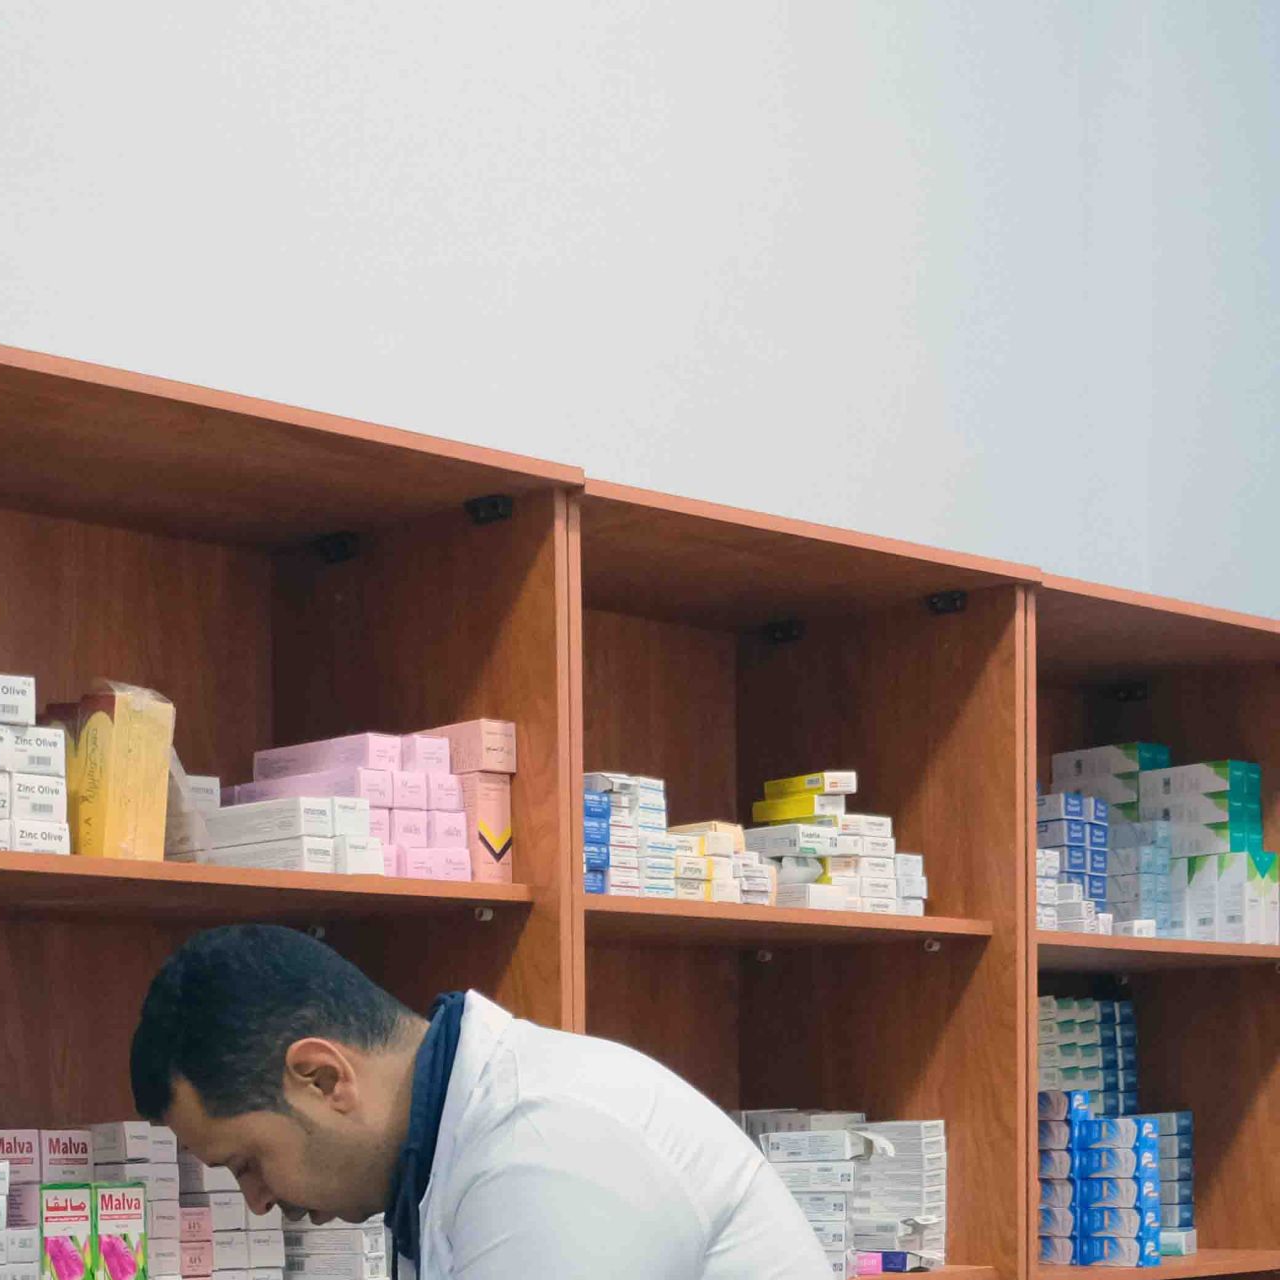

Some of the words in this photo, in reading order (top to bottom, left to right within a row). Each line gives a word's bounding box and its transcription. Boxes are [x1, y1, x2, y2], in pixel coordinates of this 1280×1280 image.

[1, 685, 27, 697] Olive
[15, 735, 33, 747] Zinc
[35, 738, 58, 748] Olive
[17, 783, 35, 793] Zinc
[38, 785, 60, 795] Olive
[19, 830, 38, 840] Zinc
[41, 832, 63, 842] Olive
[48, 1138, 88, 1155] Malva
[100, 1193, 141, 1211] Malva
